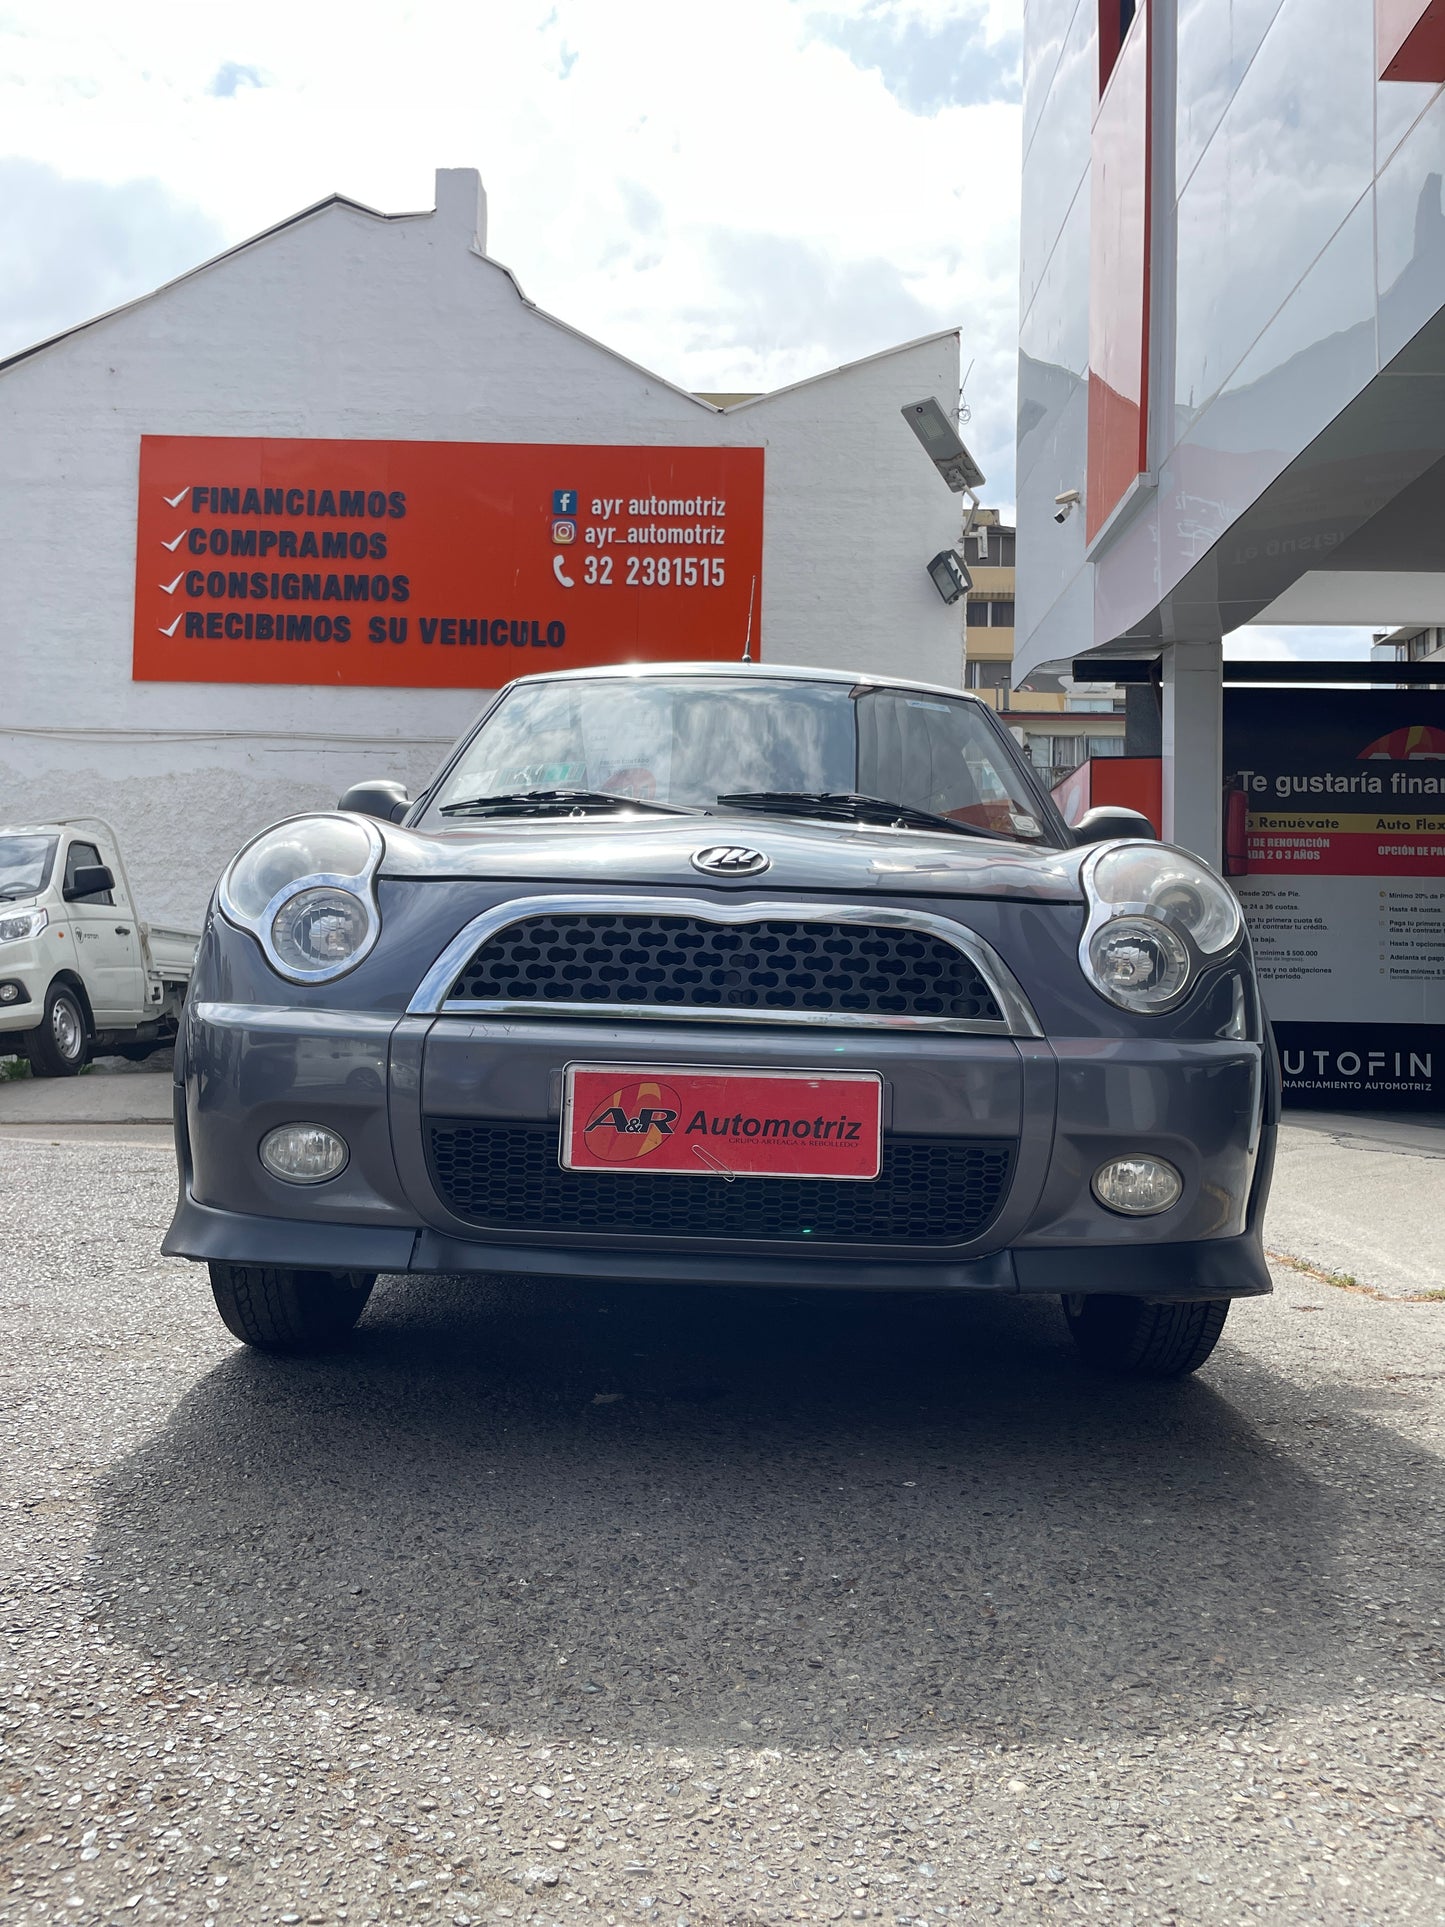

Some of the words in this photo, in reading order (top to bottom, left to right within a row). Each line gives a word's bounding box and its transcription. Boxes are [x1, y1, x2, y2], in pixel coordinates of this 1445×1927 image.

[191, 486, 407, 518] FINANCIAMOS
[591, 498, 624, 520] ayr
[628, 496, 726, 517] automotriz
[187, 527, 388, 560] COMPRAMOS
[585, 524, 726, 548] ayr_automotriz
[583, 555, 614, 585] 32
[626, 556, 725, 587] 2381515
[185, 570, 411, 602] CONSIGNAMOS
[185, 611, 352, 642] RECIBIMOS
[368, 616, 408, 644] SU
[418, 617, 567, 648] VEHICULO
[1237, 770, 1268, 792] Te
[1275, 772, 1382, 798] gustaría
[1259, 816, 1340, 829] Renuévate
[1376, 819, 1411, 830] Auto
[1253, 837, 1266, 847] DE
[1267, 837, 1330, 848] RENOVACIÓN
[1267, 850, 1274, 860] 2
[1285, 850, 1291, 860] 3
[1293, 849, 1321, 860] AÑOS
[1377, 845, 1415, 856] OPCIÓN
[1417, 846, 1428, 856] DE
[1430, 846, 1445, 856] PA
[1284, 1050, 1432, 1078] UTOFIN
[1283, 1080, 1362, 1090] NANCIAMIENTO
[1364, 1081, 1432, 1091] AUTOMOTRIZ
[583, 1107, 678, 1135] A&R
[684, 1110, 862, 1140] Automotriz
